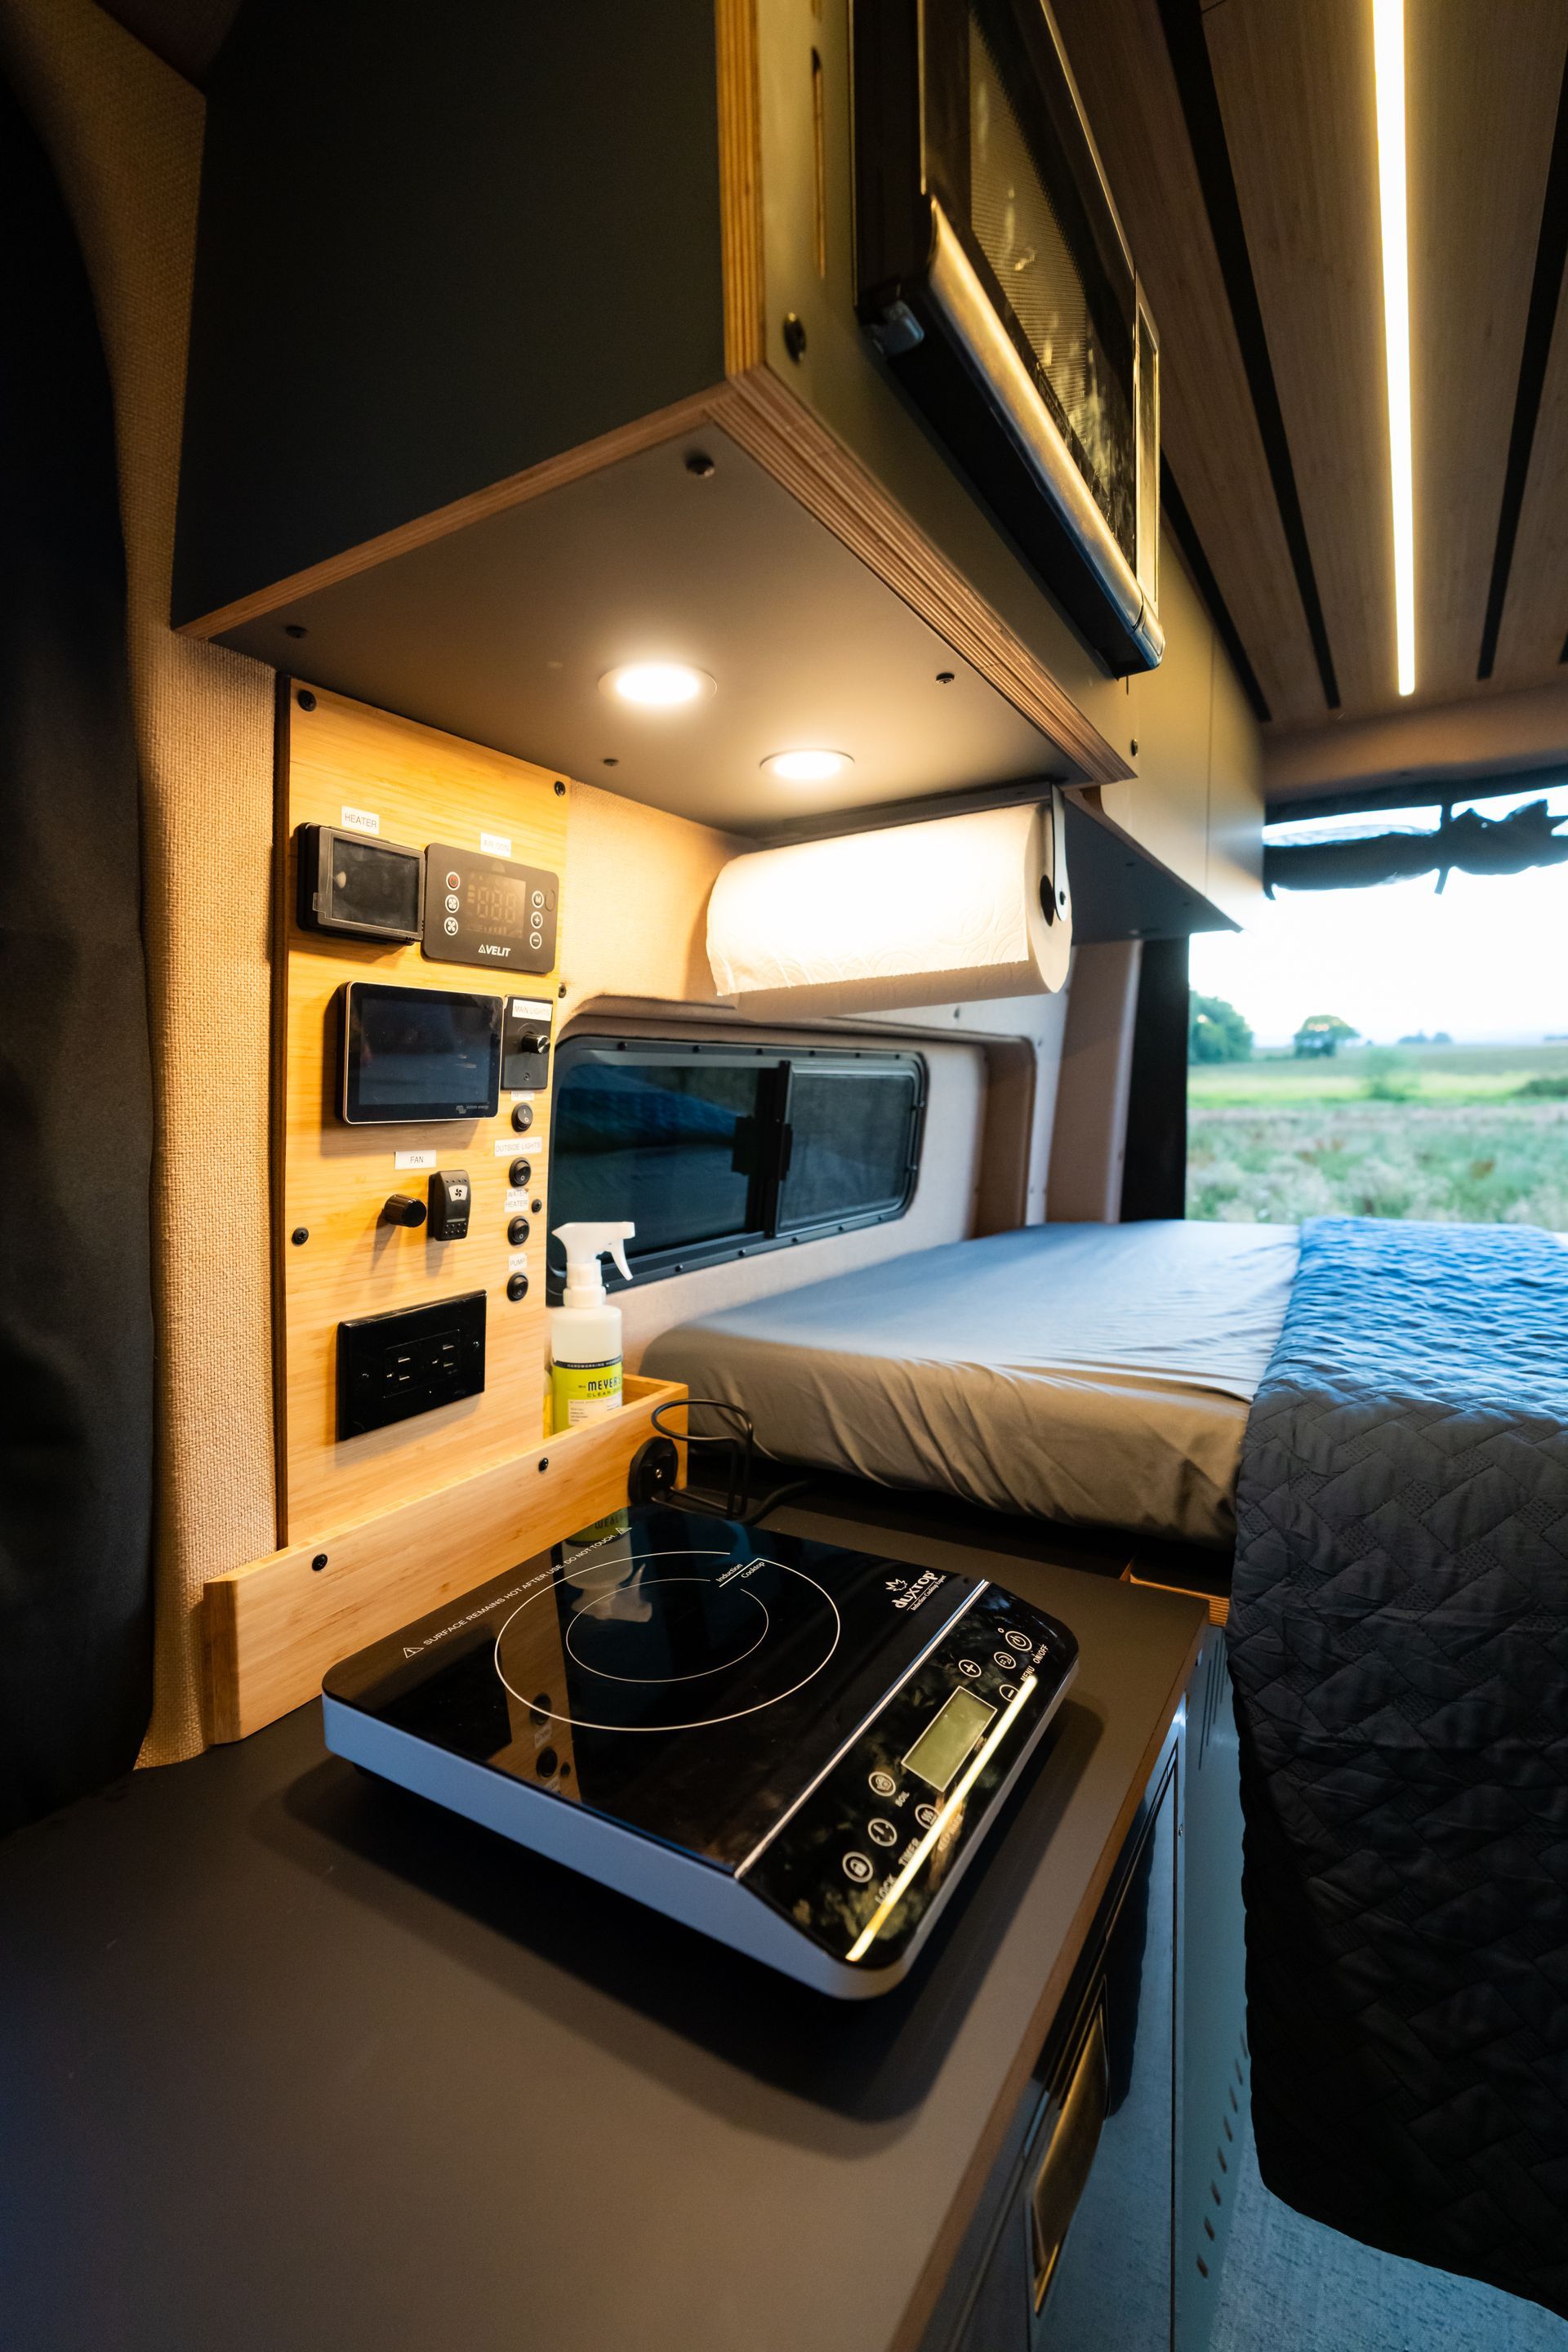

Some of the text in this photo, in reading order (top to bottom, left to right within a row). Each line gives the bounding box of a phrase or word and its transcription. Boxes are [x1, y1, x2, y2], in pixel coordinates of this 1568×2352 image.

[344, 813, 378, 828] HEATER
[486, 944, 511, 957] VELIT
[514, 1004, 528, 1013] MAIN
[495, 1141, 541, 1152] OUTSIDE LIGHTS
[410, 1156, 424, 1164] FAN
[506, 1200, 528, 1209] HEATER
[510, 1258, 526, 1267] PUMP
[715, 1563, 744, 1583] Induction
[741, 1561, 765, 1579] Cooktop
[423, 1619, 468, 1646] SURFACE
[465, 1597, 506, 1621] REMAINS
[504, 1587, 523, 1599] HOT
[522, 1572, 549, 1589] AFTER
[564, 1556, 577, 1565] DO
[575, 1547, 592, 1559] NOT
[1032, 1644, 1049, 1664] ON/OFF
[1020, 1665, 1036, 1683] MENU
[895, 1791, 911, 1807] BOIL
